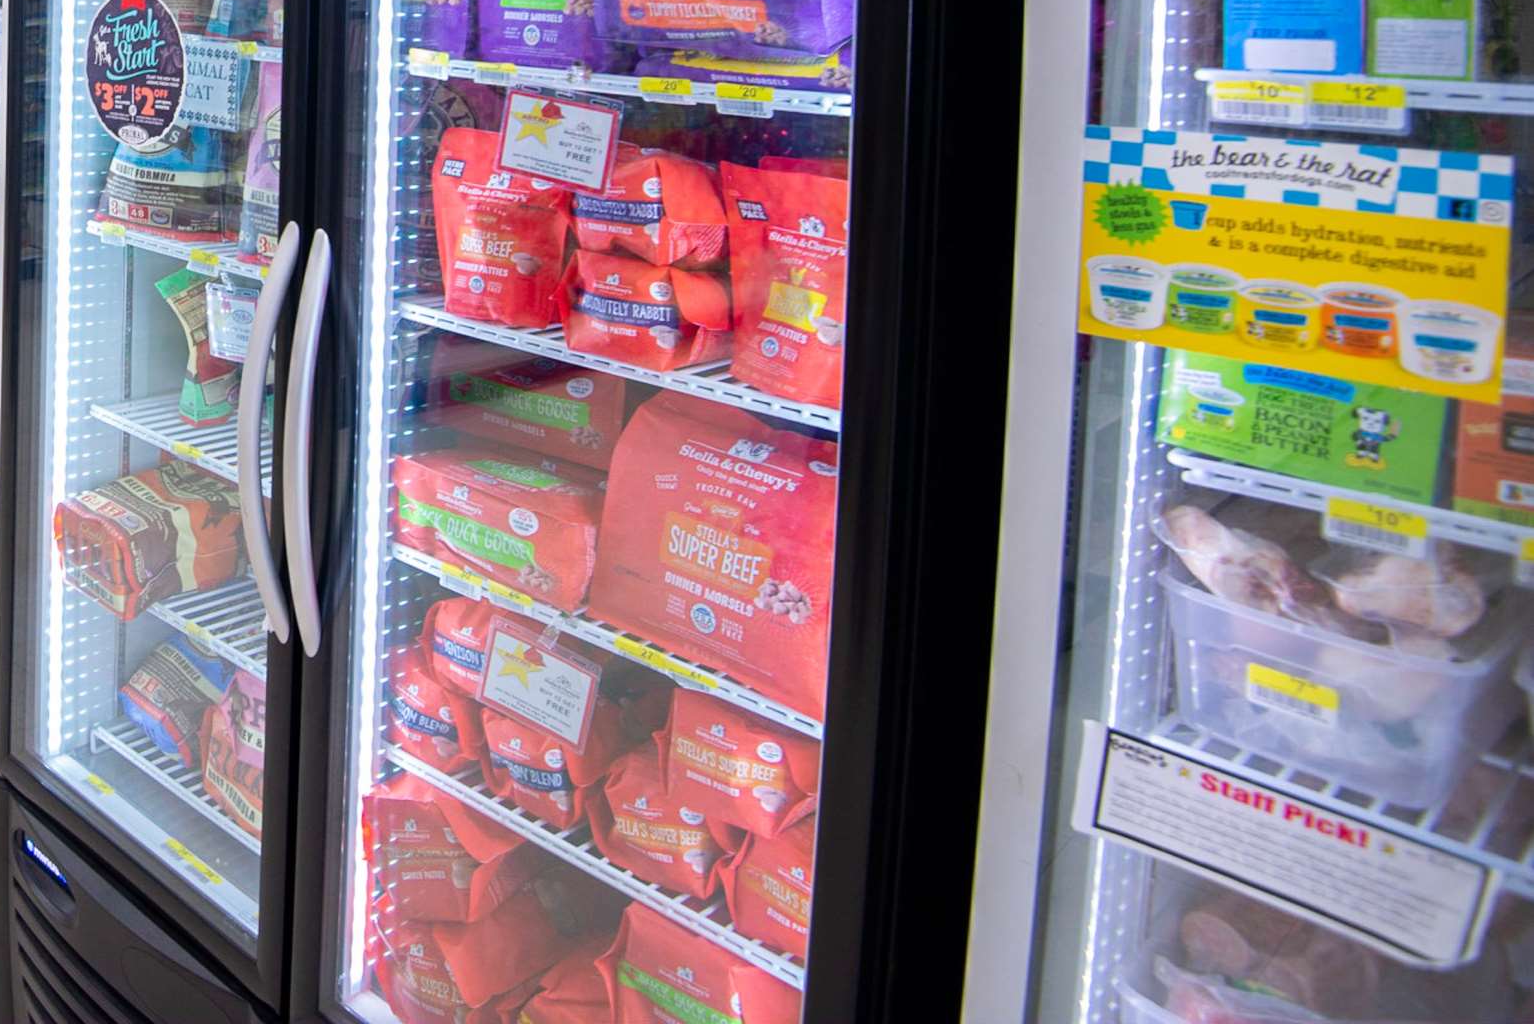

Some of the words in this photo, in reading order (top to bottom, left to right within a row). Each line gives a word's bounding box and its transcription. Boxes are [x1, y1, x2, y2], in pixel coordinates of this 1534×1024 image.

[106, 8, 161, 46] Fresh
[530, 12, 563, 24] MORSELS
[113, 41, 165, 73] Start
[186, 61, 228, 81] RIMAL
[745, 75, 790, 88] MORSELS
[94, 82, 114, 111] $3
[135, 87, 155, 116] $2
[185, 83, 214, 101] CAT
[565, 150, 592, 165] FREE
[1172, 149, 1204, 169] the
[1209, 144, 1271, 168] bear
[1297, 153, 1334, 174] the
[1336, 163, 1393, 189] rat
[135, 169, 176, 183] FORMULA
[441, 166, 463, 177] PACK
[1205, 168, 1356, 193] cooltreatsfordogs.com
[740, 207, 768, 221] PACK
[460, 234, 483, 254] SUPER
[486, 241, 515, 258] BEEF
[768, 230, 798, 246] Stella
[1206, 215, 1236, 232] cup
[1241, 214, 1286, 235] adds
[1289, 221, 1393, 250] hydration,
[1395, 235, 1488, 259] nutrients
[1207, 235, 1222, 248] &
[1228, 235, 1244, 251] is
[1248, 240, 1260, 253] a
[1263, 241, 1345, 263] complete
[1349, 250, 1439, 275] digestive
[1443, 262, 1477, 280] aid
[479, 263, 510, 278] PATTIES
[581, 294, 630, 316] ABSOLUTELY
[632, 303, 672, 322] RABBIT
[608, 325, 638, 337] PATTIES
[776, 325, 808, 345] PATTIES
[503, 389, 533, 413] DUCK
[537, 399, 580, 423] GOOSE
[1255, 407, 1332, 435] BACON
[1250, 431, 1331, 461] BUTTER
[1263, 424, 1331, 448] PEANUT
[679, 443, 719, 467] Stella
[719, 457, 733, 472] &
[733, 461, 798, 493] Chewy's
[695, 482, 733, 499] FROZEN
[736, 493, 758, 510] RAW
[446, 516, 480, 544] DUCK
[483, 531, 531, 559] GOOSE
[668, 524, 718, 570] SUPER
[720, 549, 763, 586] BEEF
[664, 571, 704, 597] DINNER
[704, 587, 755, 618] MORSELS
[545, 699, 571, 718] FREE
[418, 713, 450, 735] BLEND
[675, 736, 717, 766] STELLA'S
[718, 756, 750, 780] SUPER
[750, 762, 778, 783] BEEF
[529, 766, 563, 786] BLEND
[1200, 772, 1277, 816] Staff
[1282, 802, 1371, 849] Pick!
[650, 824, 678, 845] SUPER
[679, 830, 705, 847] BEEF
